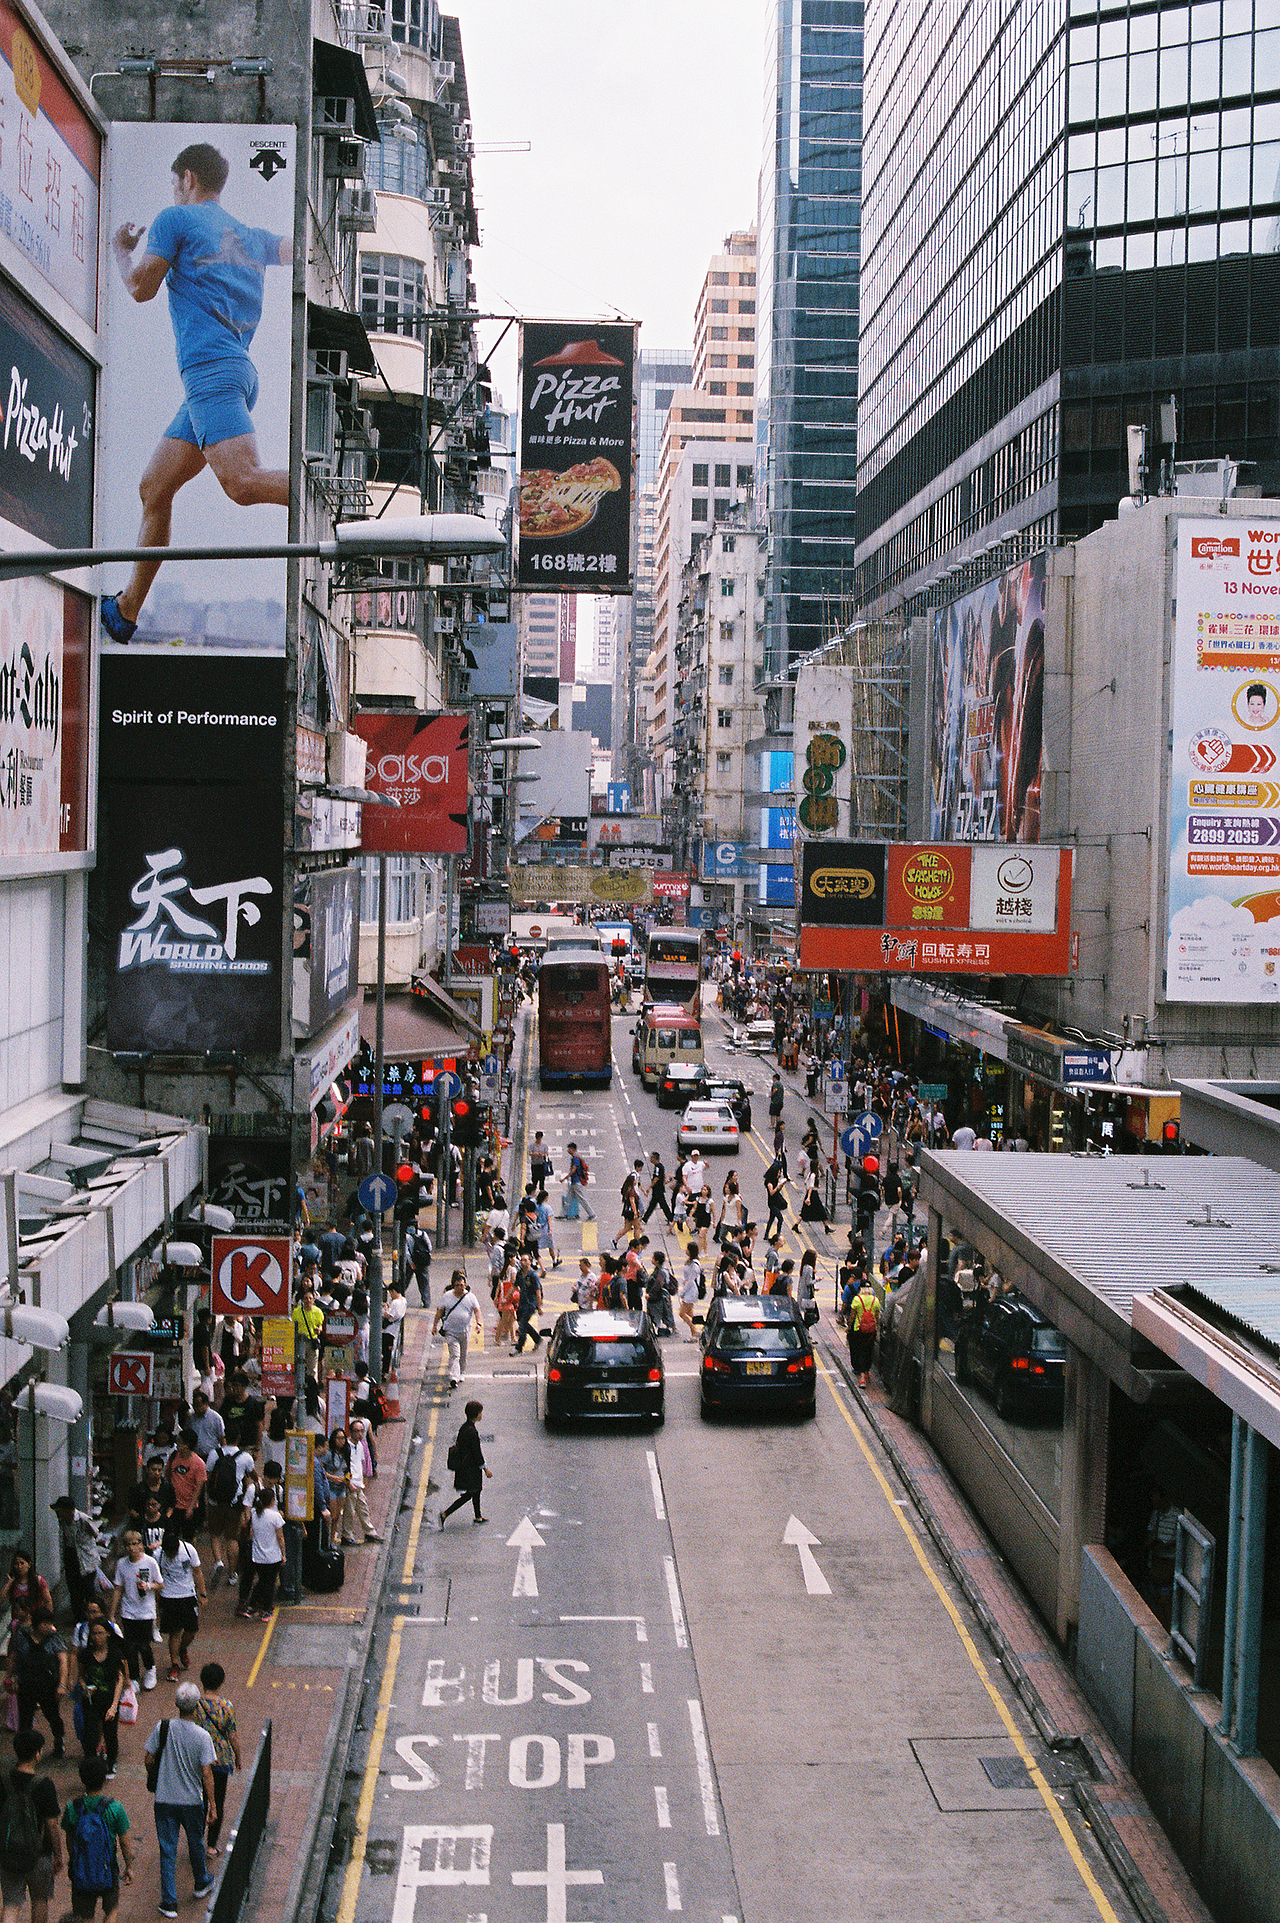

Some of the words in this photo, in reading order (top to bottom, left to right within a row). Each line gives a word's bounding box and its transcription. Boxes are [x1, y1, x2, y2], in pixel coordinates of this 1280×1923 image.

[249, 141, 287, 149] DESCENTE
[530, 368, 622, 410] Pizza
[545, 396, 618, 433] Hut
[4, 366, 48, 462] Pizza
[49, 402, 79, 483] Hut
[562, 435, 587, 446] Pizza
[589, 436, 597, 446] &
[598, 437, 624, 447] More
[530, 553, 617, 573] 168號2樓
[1247, 549, 1280, 576] 世
[1224, 581, 1238, 594] 13
[1241, 582, 1280, 595] Nove
[112, 709, 153, 726] Spirit
[157, 710, 174, 725] of
[177, 710, 278, 727] Performance
[386, 787, 421, 805] 莎莎
[608, 789, 630, 812] i.t
[1192, 817, 1221, 828] Enquiry
[1192, 828, 1225, 843] 2899
[1227, 829, 1259, 844] 2035
[916, 854, 939, 868] THE
[818, 876, 868, 893] 大家樂
[906, 867, 950, 885] SPAGHETTI
[914, 884, 944, 899] HOUSE
[126, 848, 273, 962] 天下
[996, 897, 1032, 916] 越棧
[119, 924, 224, 969] WORLD
[922, 942, 990, 959] 回転寿司
[170, 961, 227, 970] SPORTING
[229, 962, 269, 971] GOODS
[358, 1062, 417, 1084] 中藥房
[220, 1162, 288, 1219] 天下
[231, 1252, 278, 1305] K
[119, 1360, 145, 1391] K
[421, 1656, 592, 1707] BUS
[390, 1733, 616, 1792] STOP
